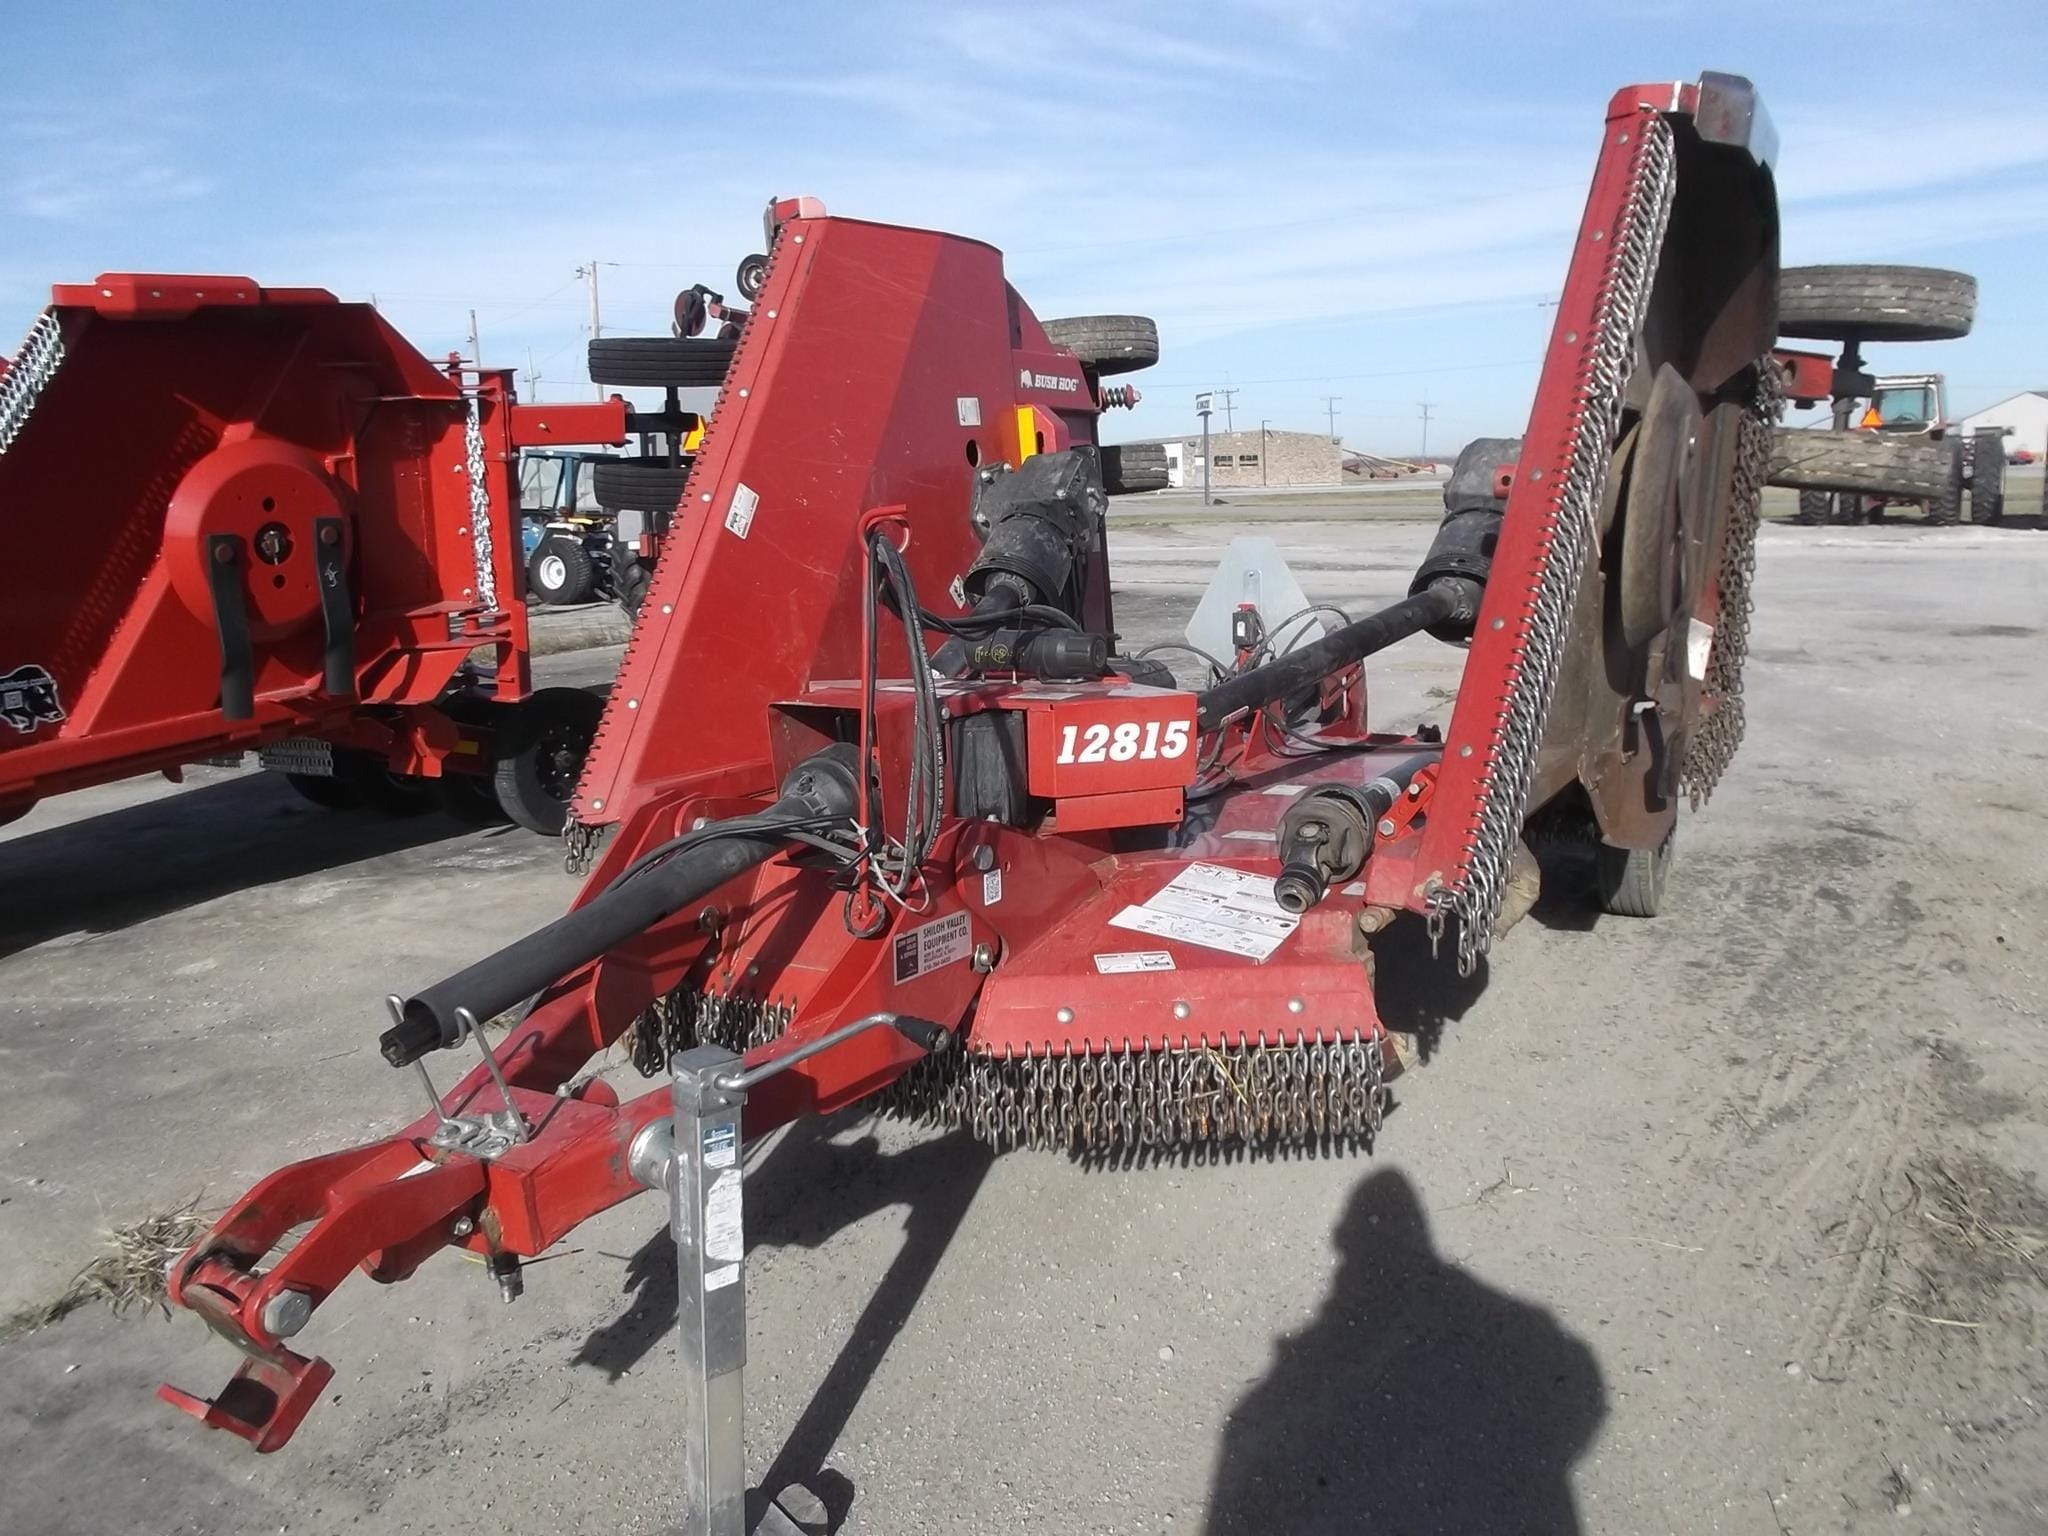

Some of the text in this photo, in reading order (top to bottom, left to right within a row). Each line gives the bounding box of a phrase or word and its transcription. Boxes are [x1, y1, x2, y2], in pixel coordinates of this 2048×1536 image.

[1035, 374, 1077, 392] BUSH HOG
[1056, 720, 1190, 764] 12815
[923, 914, 966, 938] SHILOH VALLEY
[923, 932, 957, 951] EQUIPMENT
[958, 926, 968, 937] CO.
